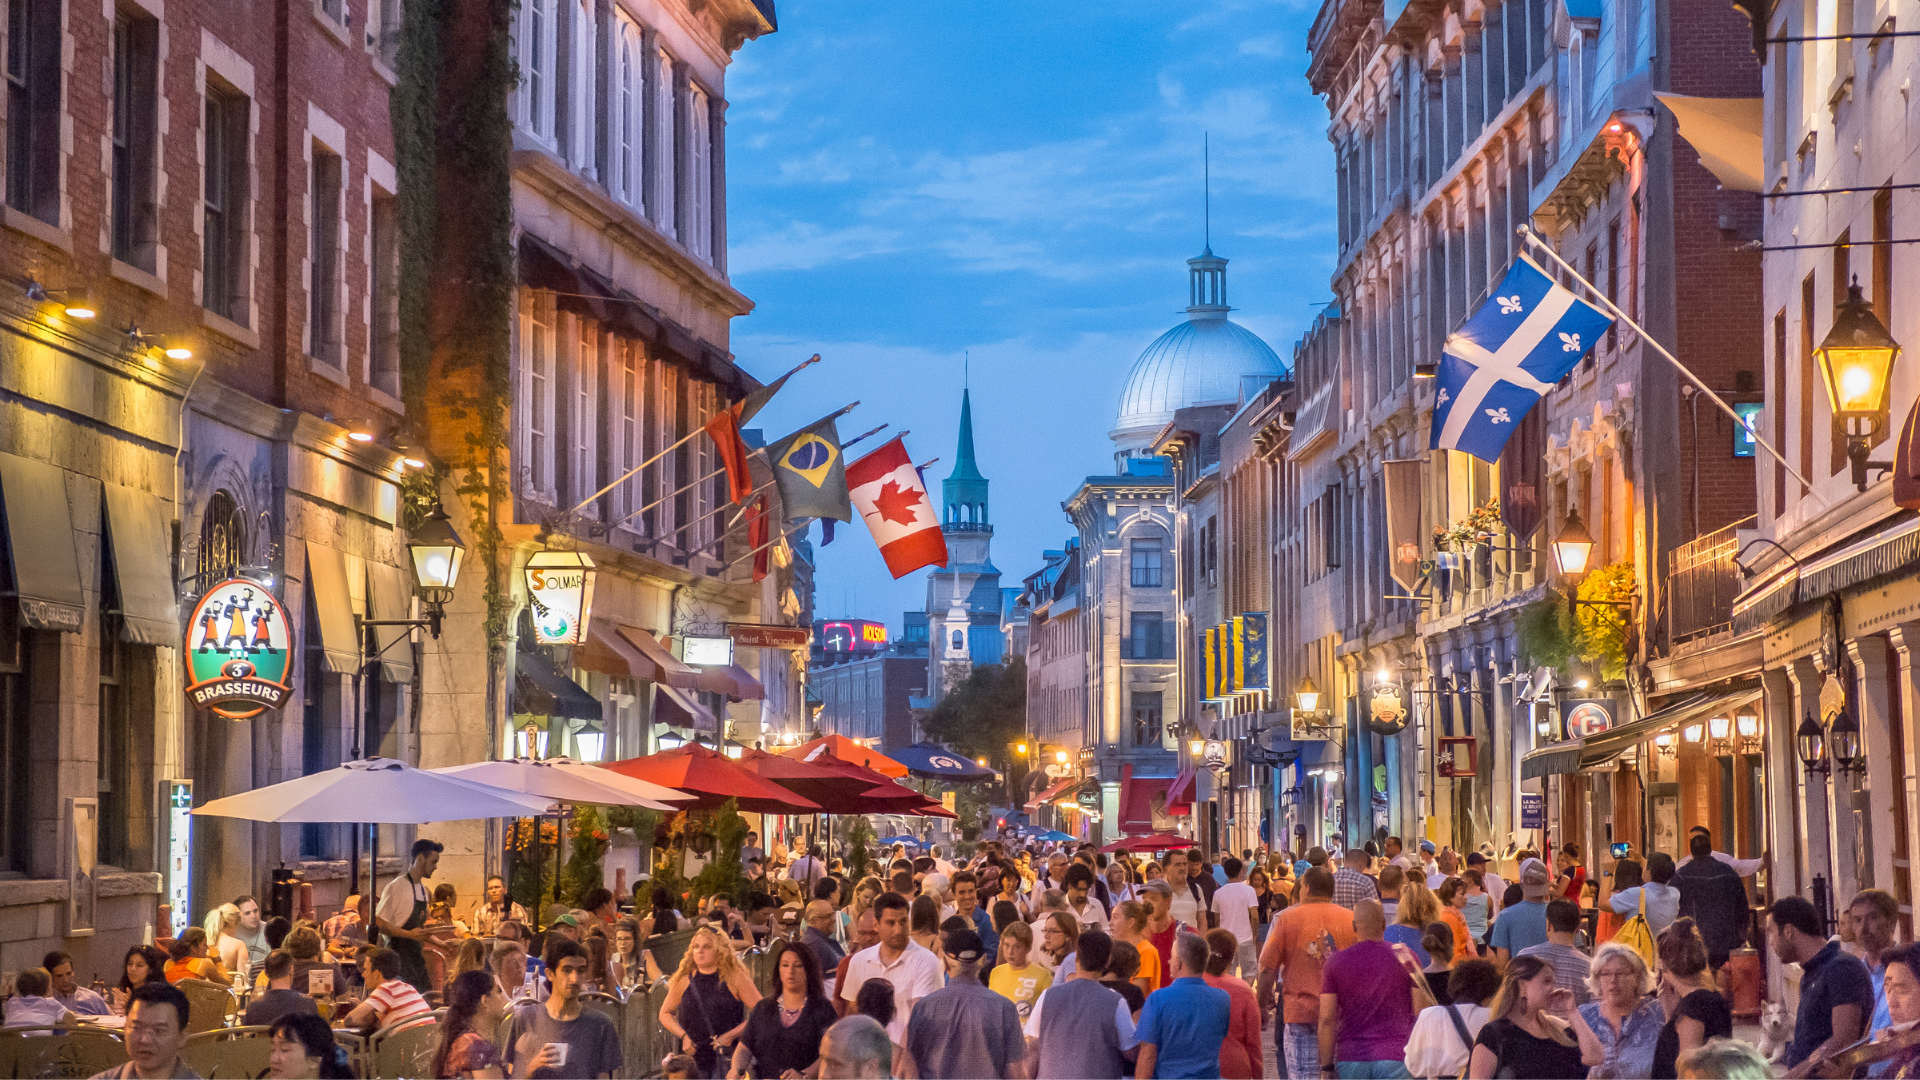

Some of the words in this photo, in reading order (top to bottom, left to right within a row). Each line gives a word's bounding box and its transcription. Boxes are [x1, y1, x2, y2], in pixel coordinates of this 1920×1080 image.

[531, 569, 582, 591] SOLMAR
[862, 624, 887, 643] MOLSON
[232, 664, 243, 677] 3
[195, 682, 280, 703] BRASSEURS
